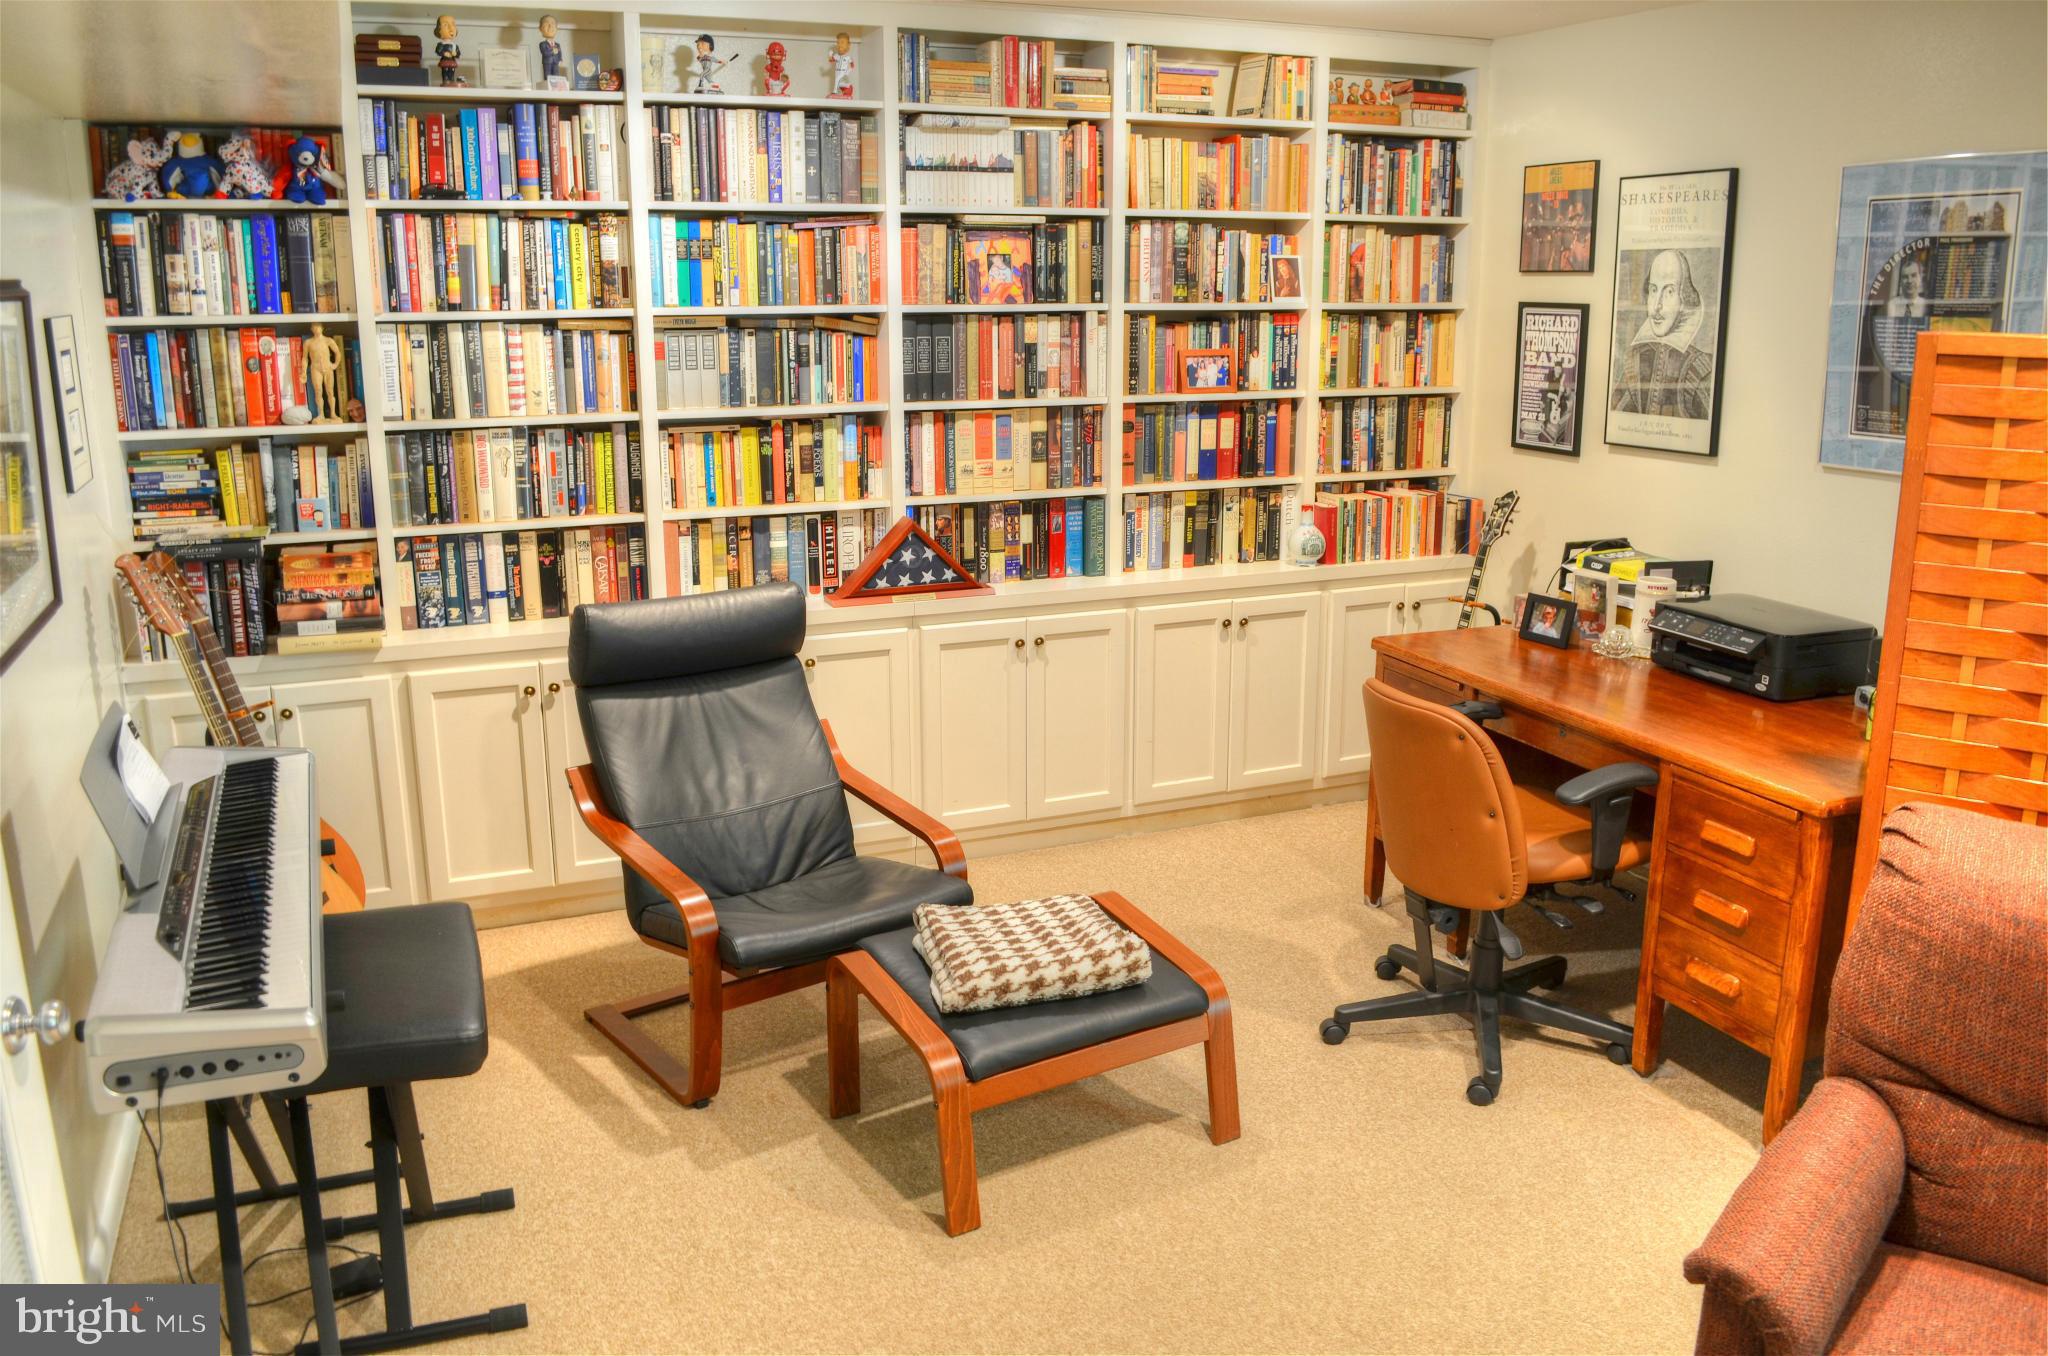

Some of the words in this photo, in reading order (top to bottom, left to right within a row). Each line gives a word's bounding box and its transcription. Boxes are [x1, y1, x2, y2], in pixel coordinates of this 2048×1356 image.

[467, 141, 476, 165] Century
[586, 139, 596, 185] NIETZSCHE
[773, 140, 781, 170] JESUS
[368, 160, 377, 189] SOROS
[469, 166, 478, 191] Culture
[749, 158, 757, 200] CHRISTIANS
[1621, 190, 1728, 206] SHAKESPEARES
[318, 217, 327, 248] VIETNAM
[574, 228, 582, 261] century
[576, 266, 584, 282] city
[1870, 275, 1885, 295] THE
[1884, 237, 1931, 272] DIRECTOR
[1526, 315, 1578, 332] RICHARD
[437, 327, 447, 361] DONALD
[1525, 331, 1577, 353] THOMPSON
[1524, 352, 1576, 368] BAND
[434, 367, 442, 393] Unknown
[440, 362, 450, 407] RUMSFELD
[476, 434, 488, 449] BOB
[1084, 424, 1094, 444] 1776
[1257, 415, 1265, 442] CADILLAC
[291, 450, 299, 480] ARABS
[631, 442, 641, 479] ALIGNMENT
[1257, 443, 1265, 464] DESERT
[221, 465, 231, 496] PERELMAN
[360, 454, 368, 493] EVOLUTION
[477, 450, 489, 489] WOODWARD
[1095, 505, 1103, 522] THE
[1285, 489, 1295, 525] Dutch
[728, 524, 738, 563] CICERO
[825, 525, 834, 575] HITLER
[841, 516, 854, 569] EUROPE
[1095, 524, 1104, 571] EUROPEAN
[980, 547, 988, 570] 1800
[243, 568, 257, 611] PYNCHON
[594, 556, 609, 594] CAESAR
[230, 589, 241, 616] ORHAN
[234, 618, 244, 643] PAMUK
[248, 622, 260, 646] EDGE
